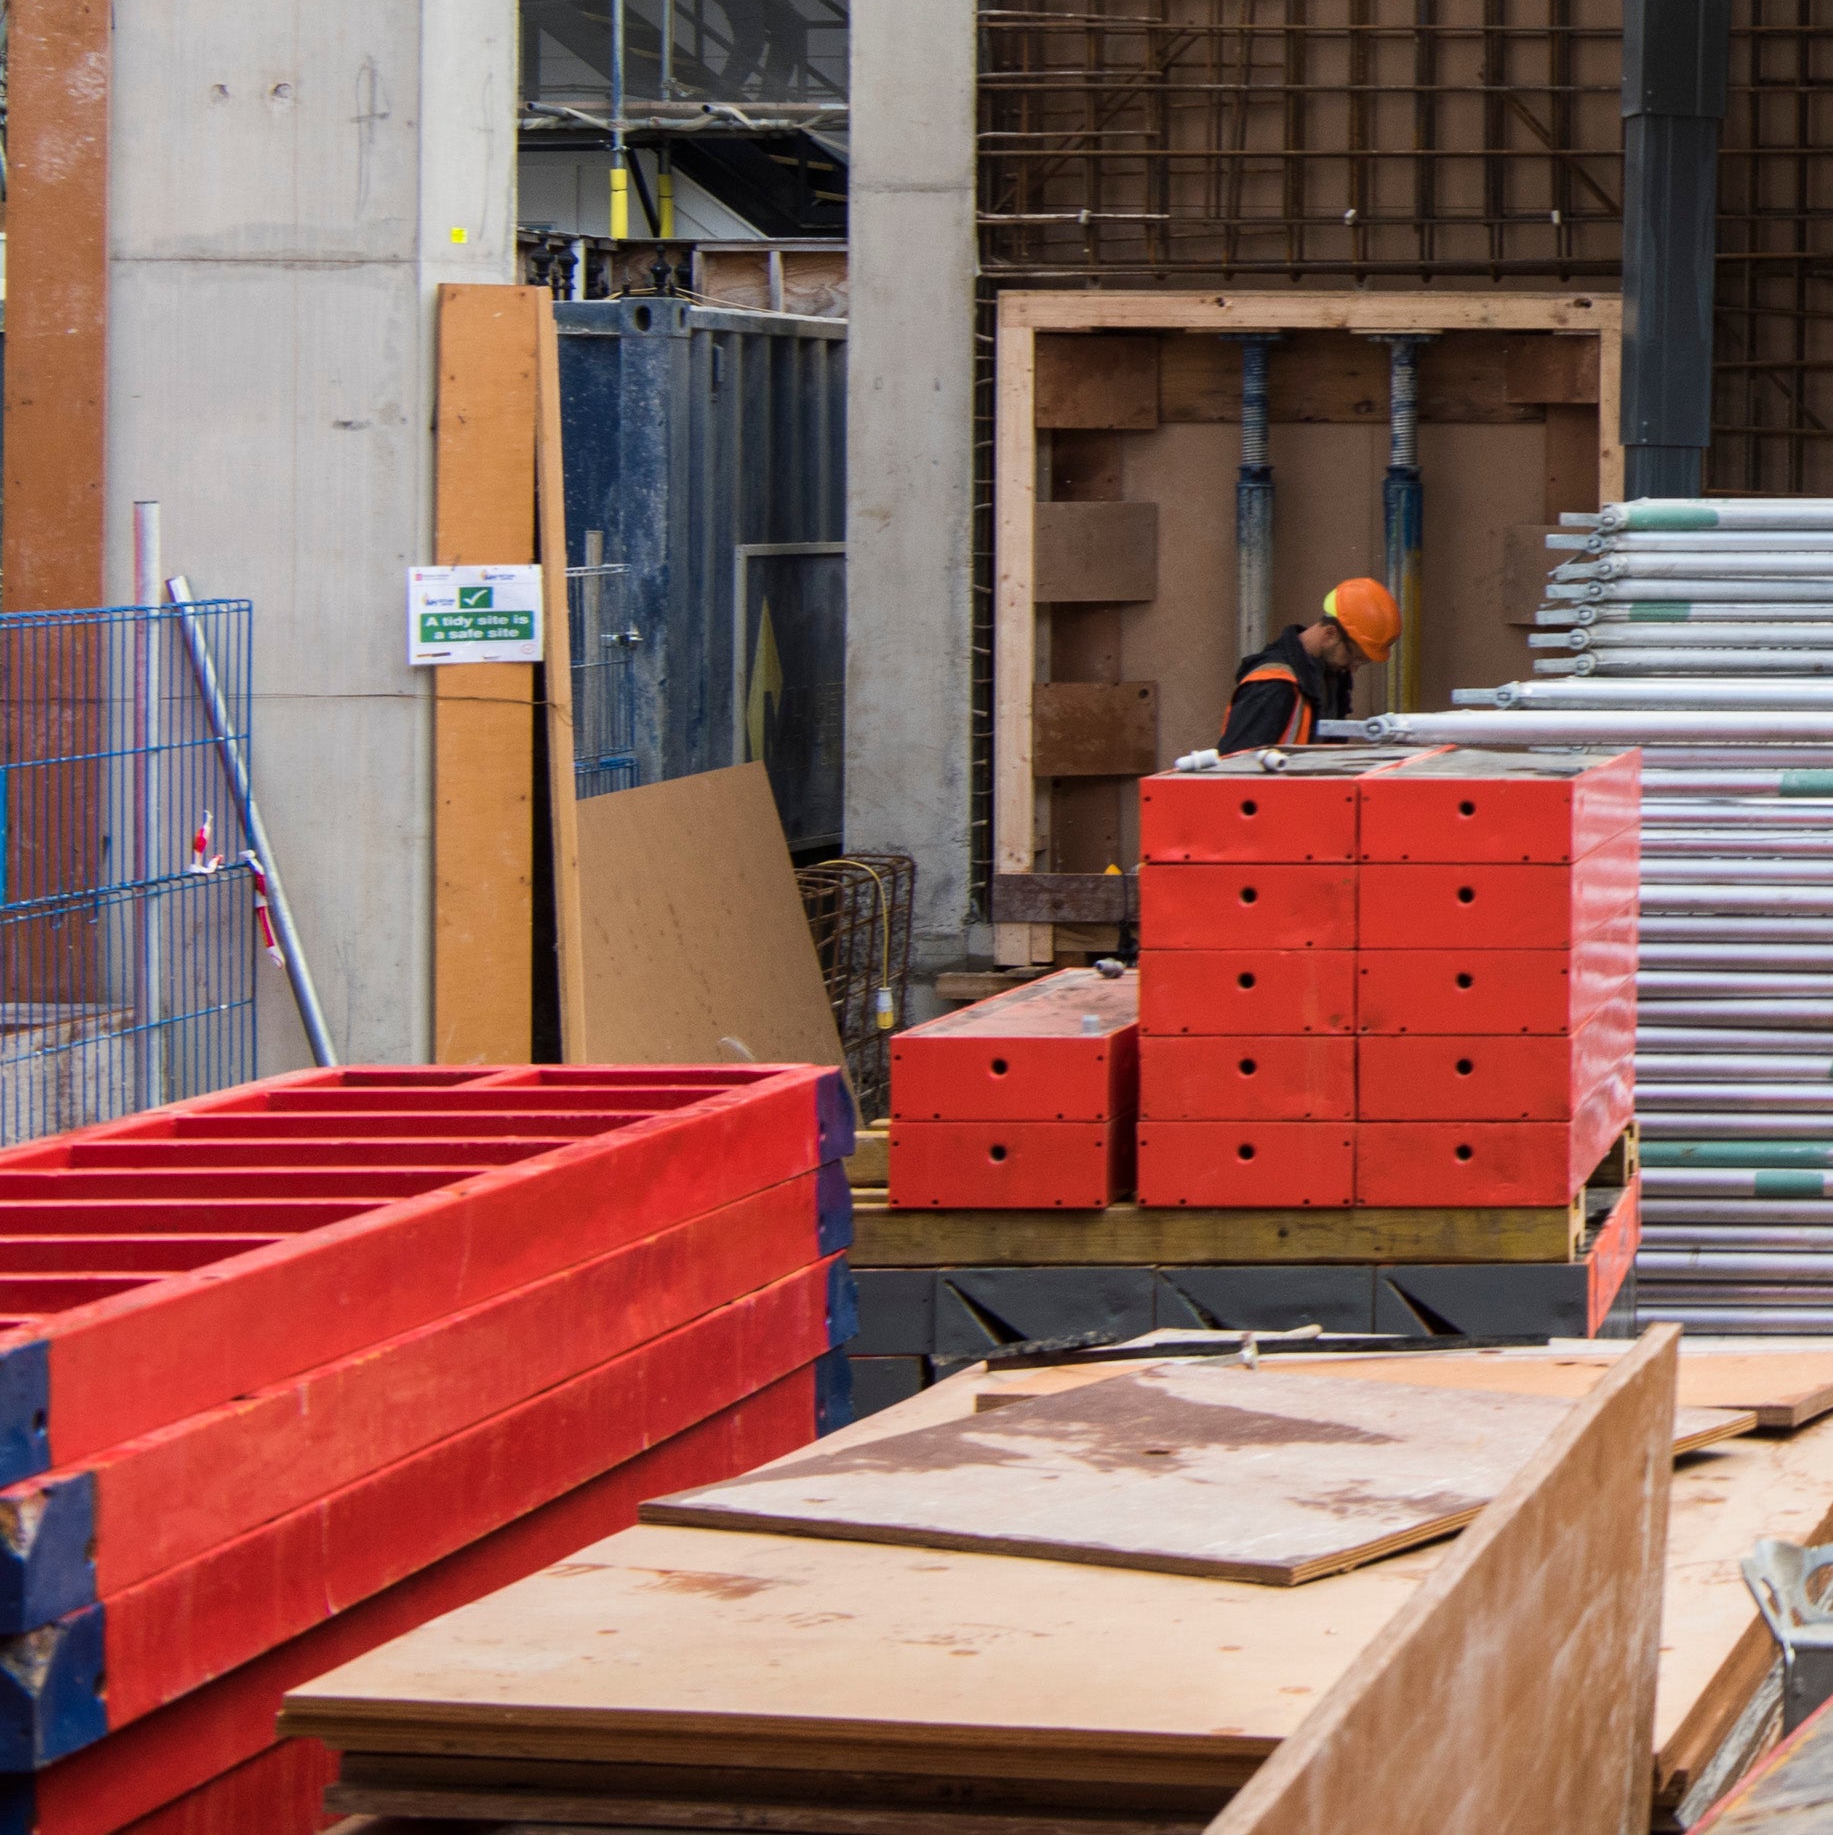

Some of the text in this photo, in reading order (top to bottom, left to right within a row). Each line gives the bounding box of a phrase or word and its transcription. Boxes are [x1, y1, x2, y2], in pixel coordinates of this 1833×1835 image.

[425, 614, 529, 627] A tidy site is
[434, 627, 519, 640] a safe site
